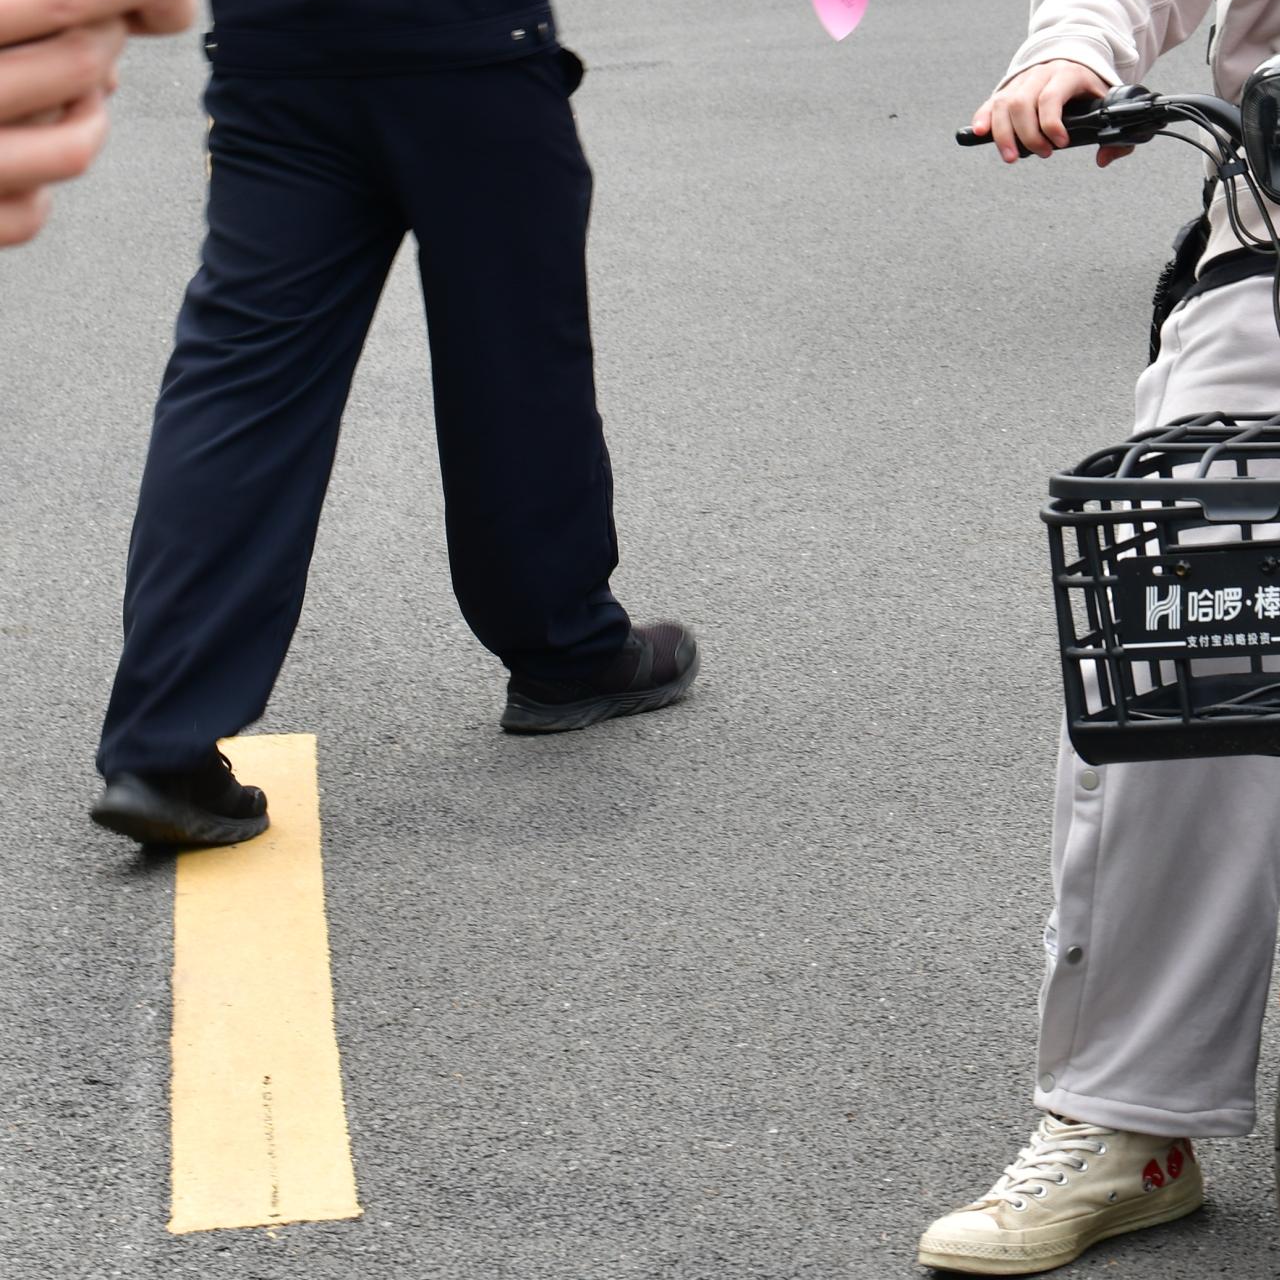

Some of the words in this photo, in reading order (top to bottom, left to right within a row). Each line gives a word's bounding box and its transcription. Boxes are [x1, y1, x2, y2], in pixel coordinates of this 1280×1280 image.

[1186, 631, 1271, 648] 支付宝战略投资
